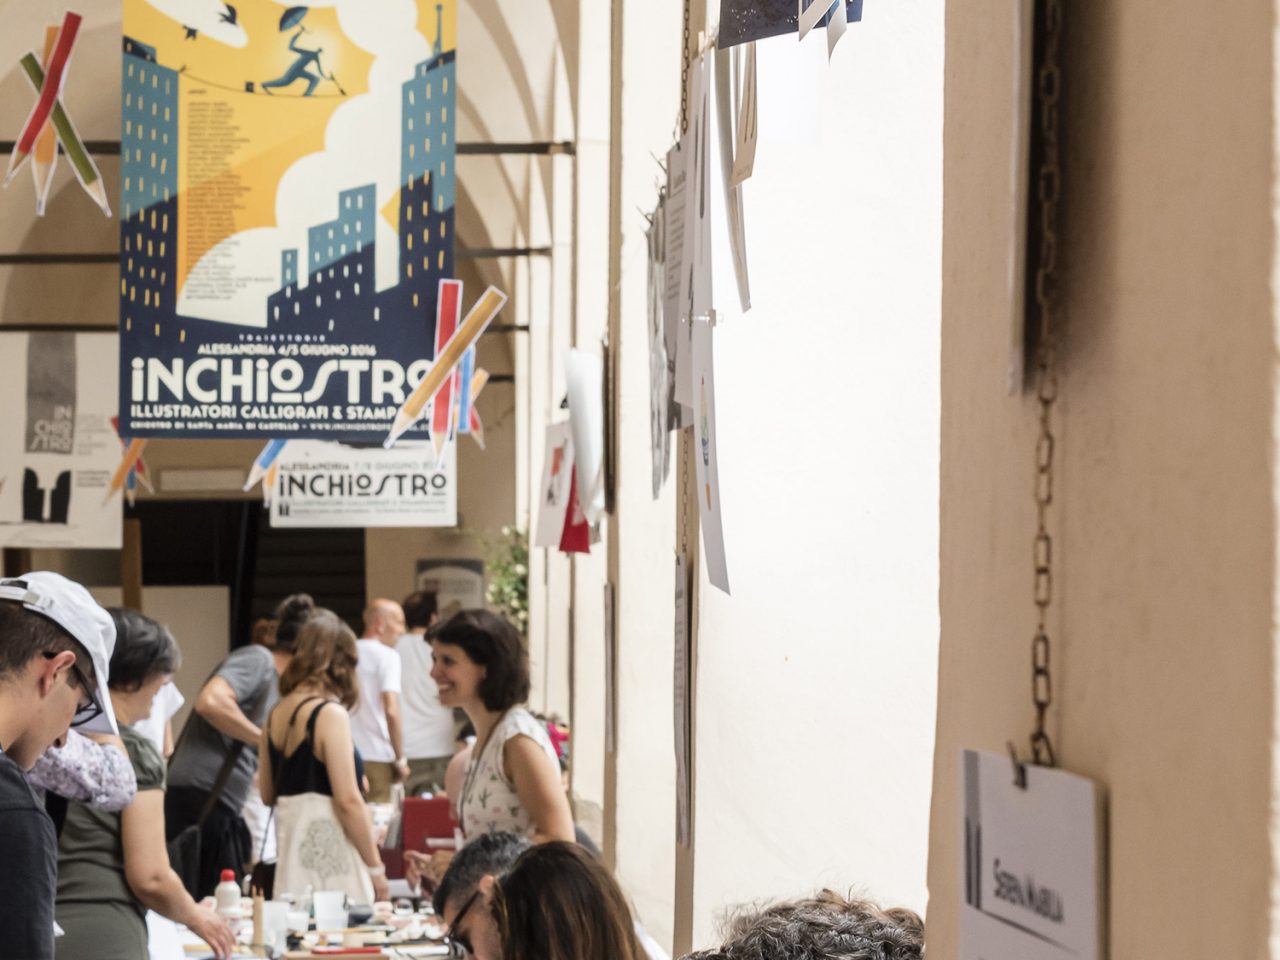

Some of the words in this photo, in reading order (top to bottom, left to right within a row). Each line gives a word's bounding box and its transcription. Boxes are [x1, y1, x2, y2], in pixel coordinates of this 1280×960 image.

[198, 344, 276, 355] ALESSANDRIA
[300, 344, 349, 356] GIUGNO
[130, 404, 236, 418] ILLUSTRATORI
[240, 405, 328, 419] CALLIGRAFI
[332, 405, 343, 419] &
